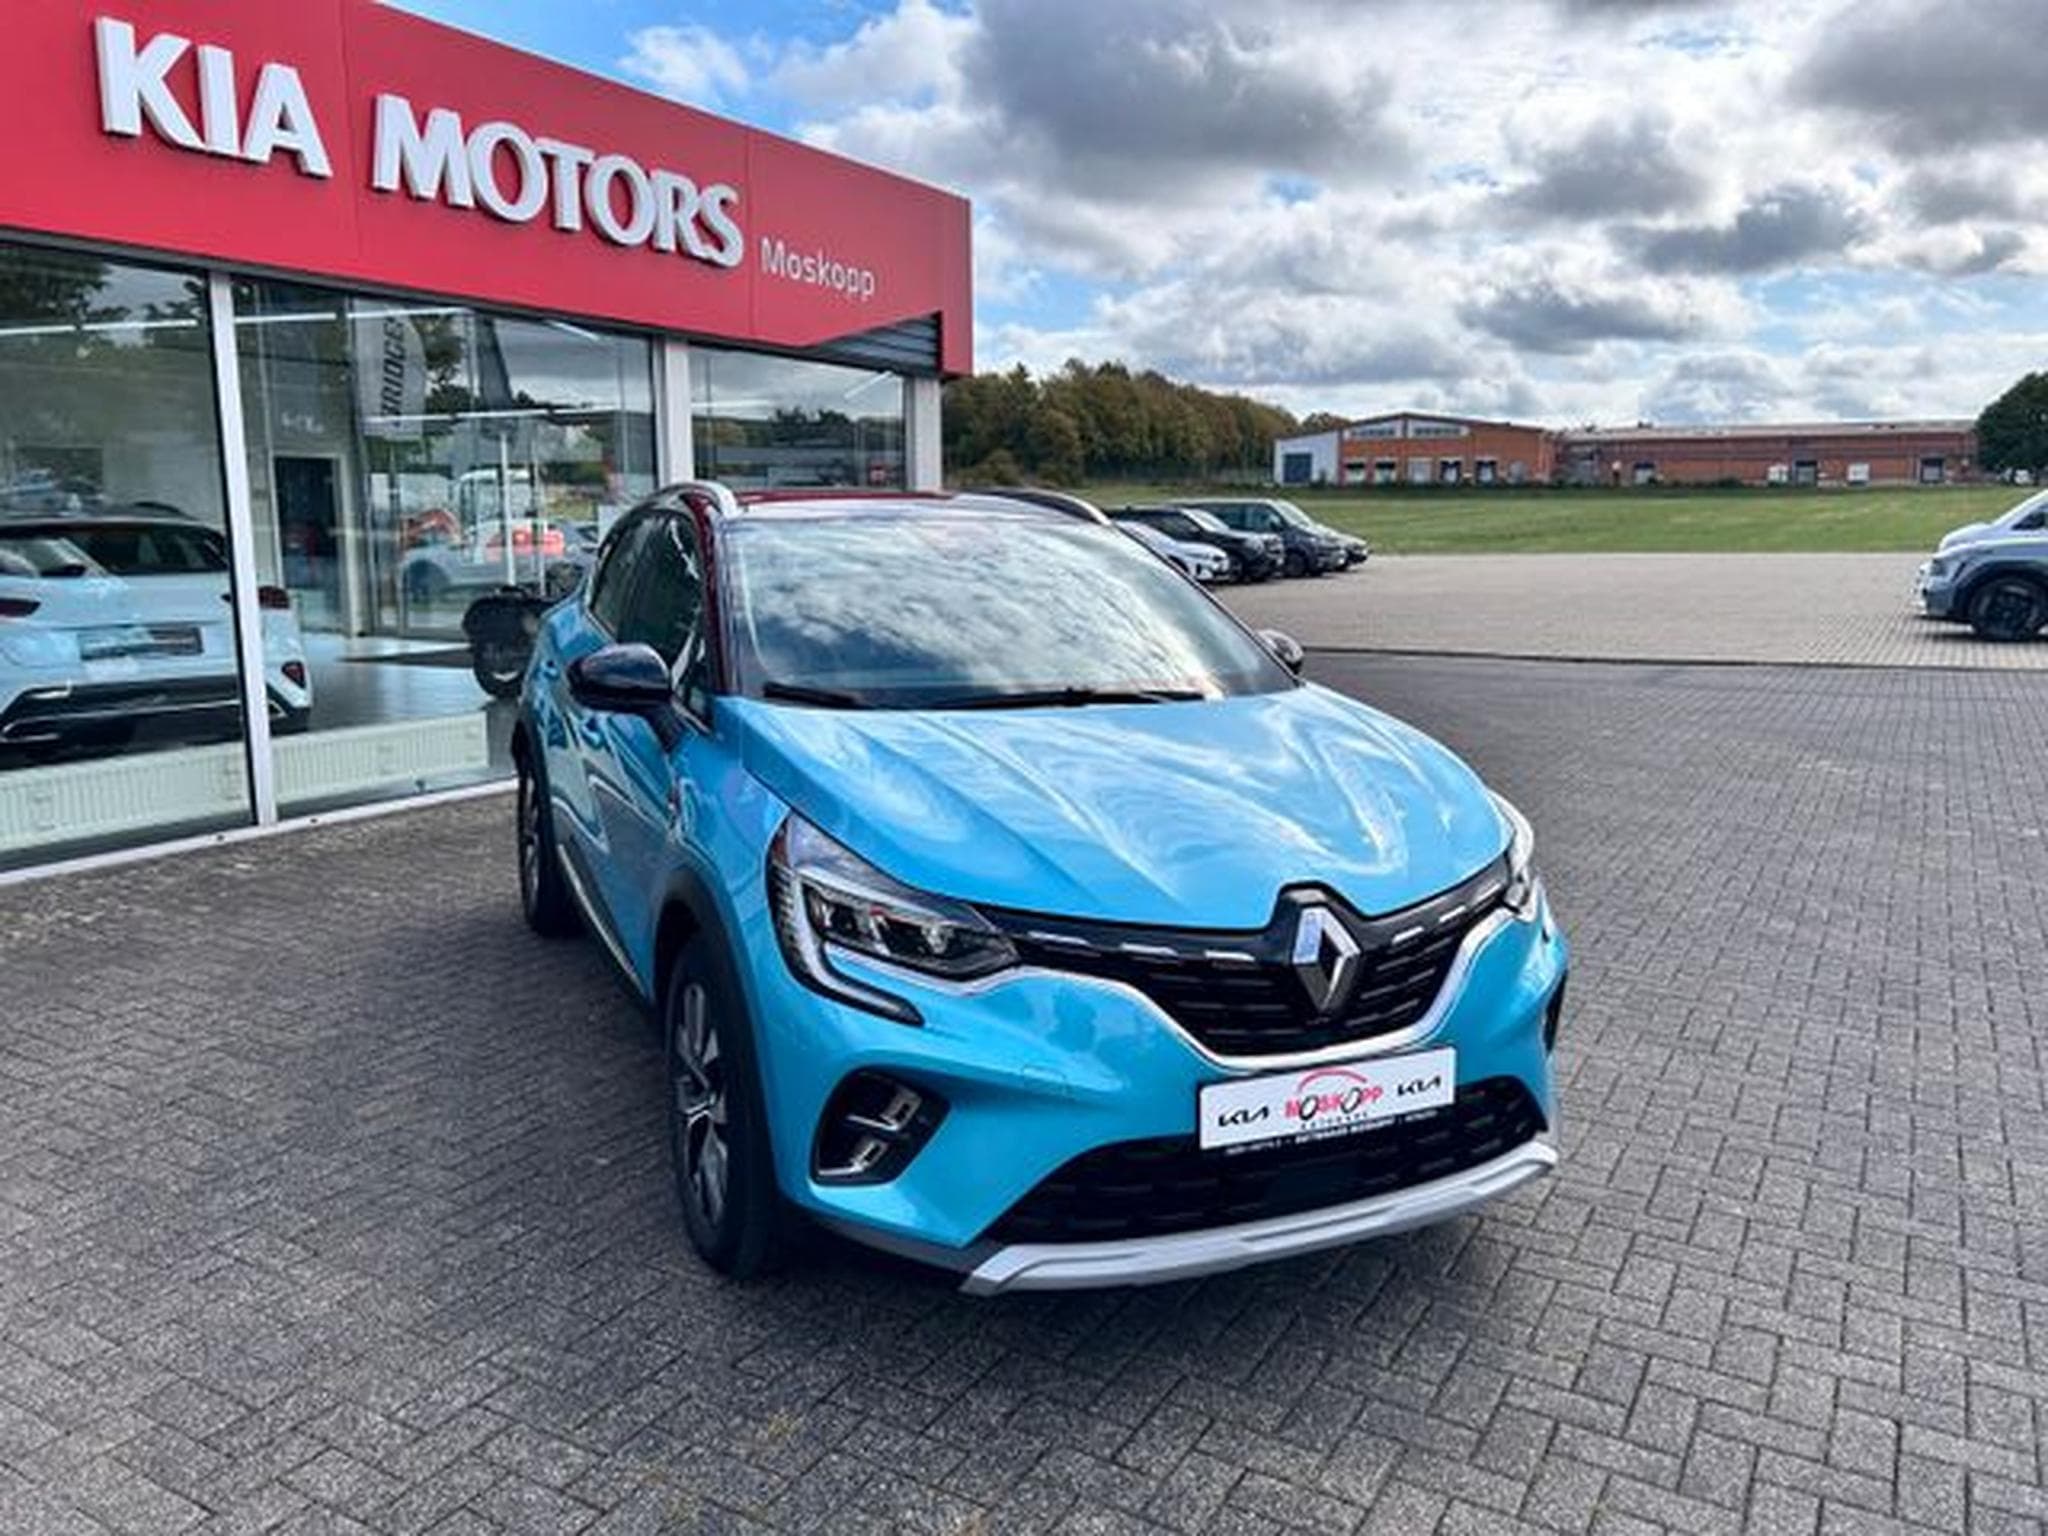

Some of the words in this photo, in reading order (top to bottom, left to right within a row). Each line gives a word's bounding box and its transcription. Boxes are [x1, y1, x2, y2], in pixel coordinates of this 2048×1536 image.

[95, 15, 334, 179] KIA
[372, 93, 744, 269] MOTORS
[761, 236, 876, 302] Moskopp
[381, 316, 406, 416] BRIDGE
